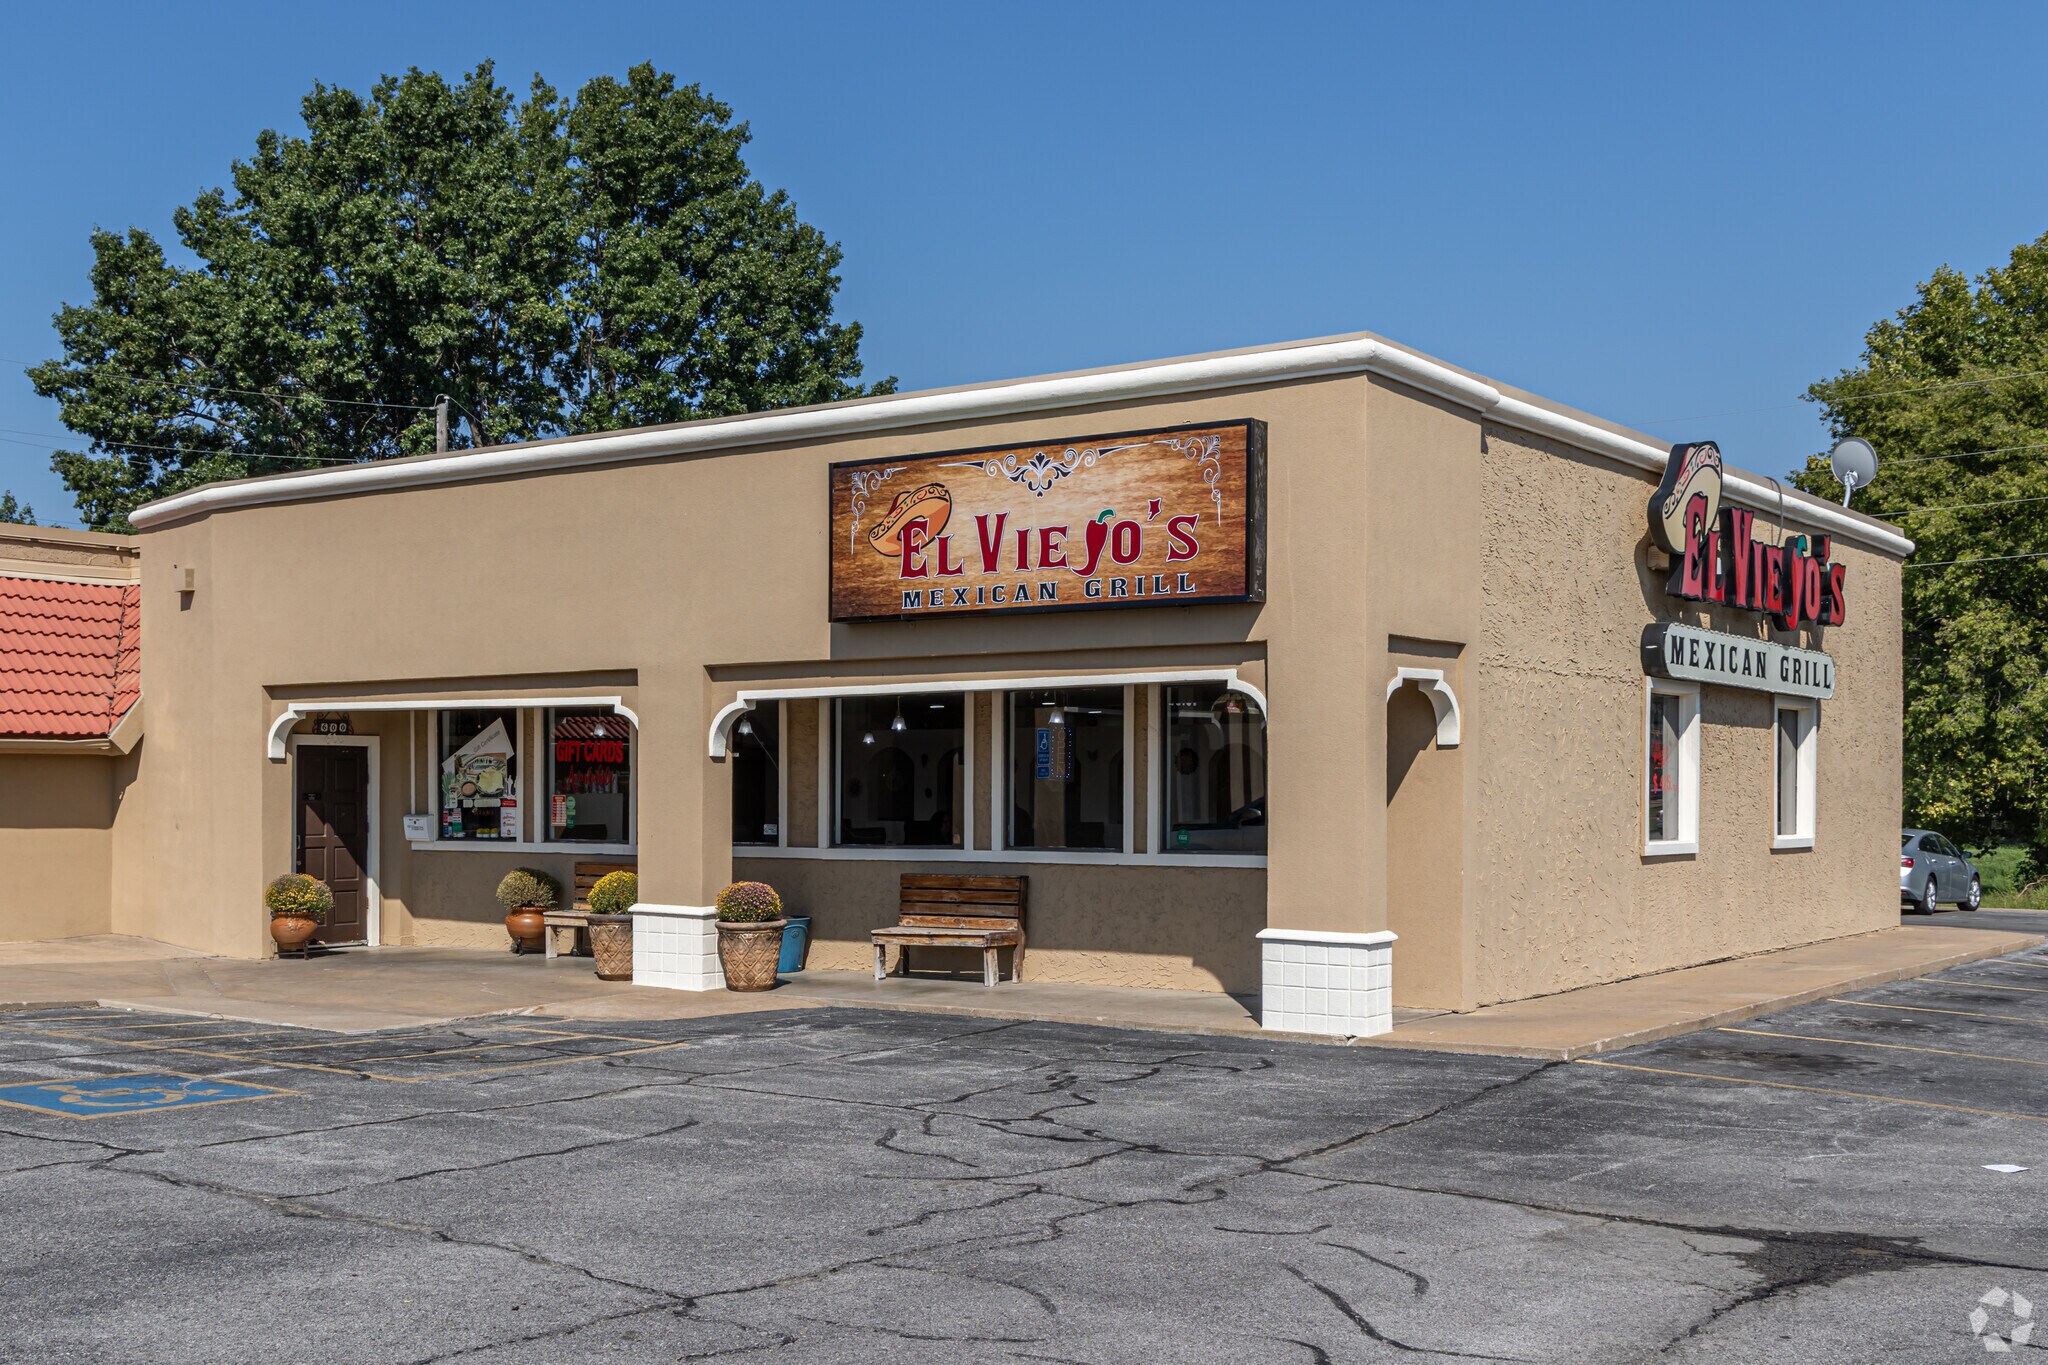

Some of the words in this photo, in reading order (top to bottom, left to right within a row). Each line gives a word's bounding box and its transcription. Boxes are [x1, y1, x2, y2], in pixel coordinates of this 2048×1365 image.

[900, 516, 965, 580] EL
[974, 498, 1200, 578] VIEJO'S
[1681, 492, 1726, 601] EL
[901, 581, 1059, 610] MEXICAN
[1084, 573, 1196, 598] GRILL
[1670, 635, 1767, 680] MEXICAN
[1780, 655, 1832, 690] GRILL
[556, 740, 582, 762] GIFT
[583, 740, 624, 763] CARDS
